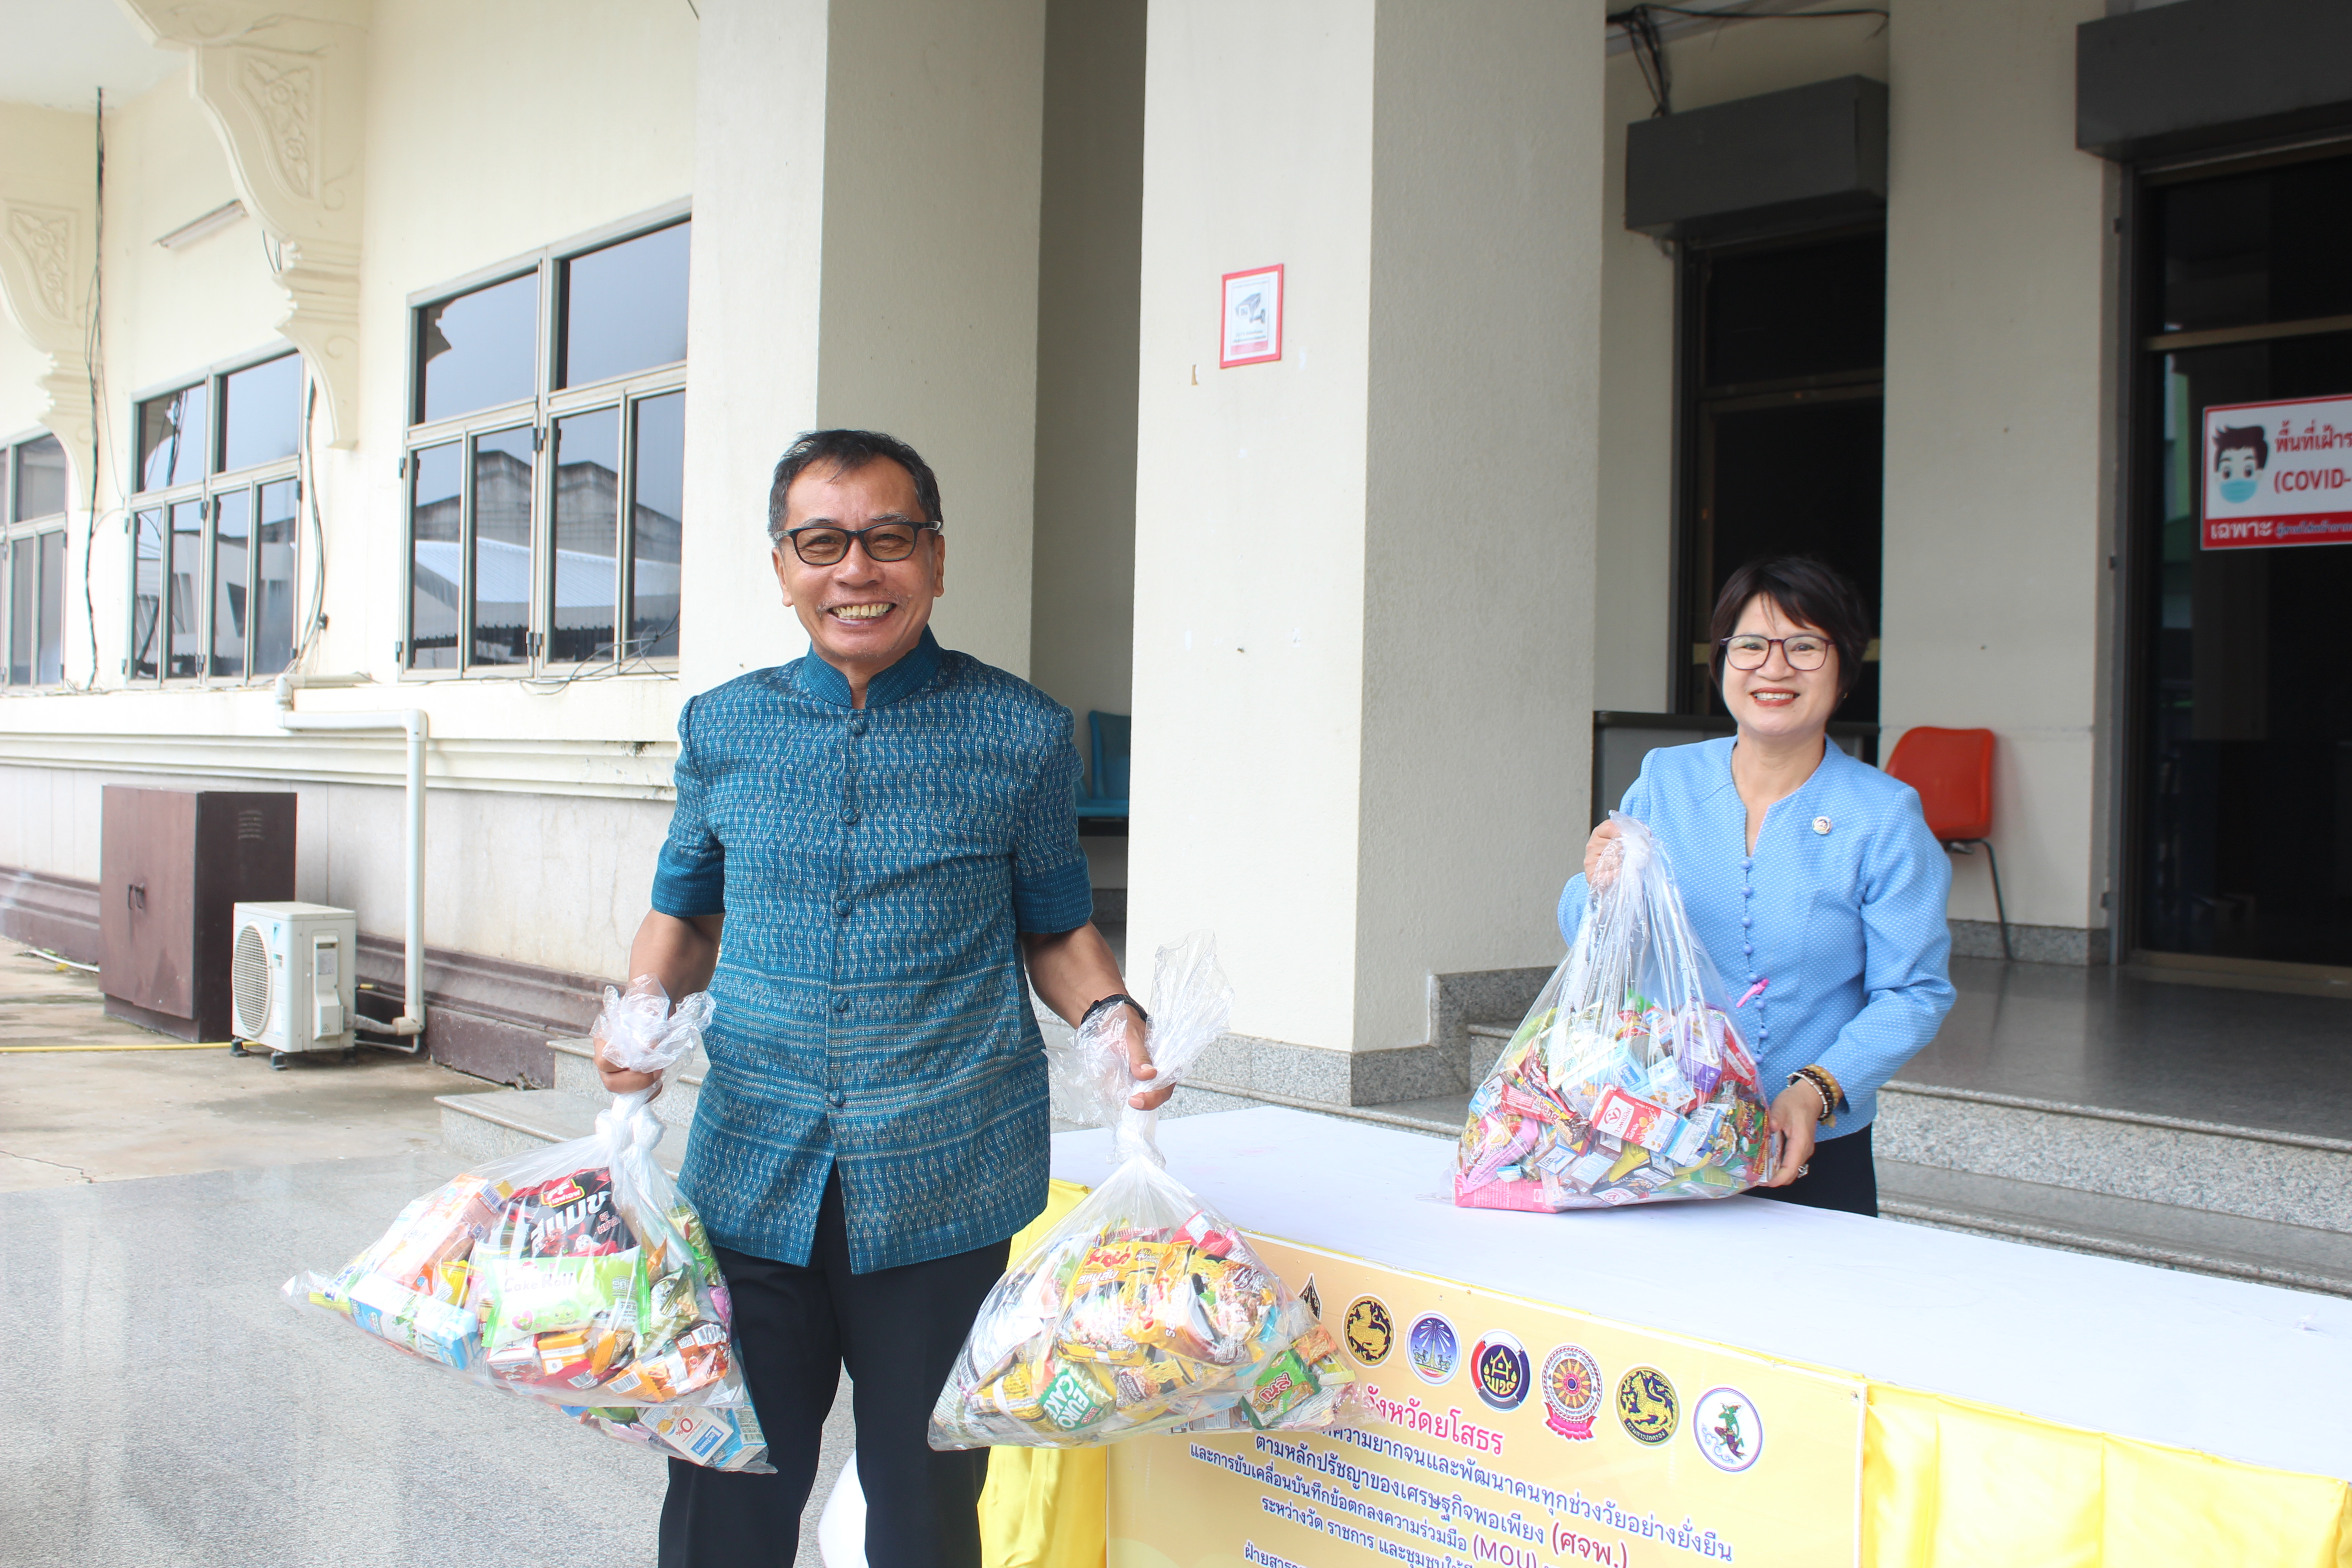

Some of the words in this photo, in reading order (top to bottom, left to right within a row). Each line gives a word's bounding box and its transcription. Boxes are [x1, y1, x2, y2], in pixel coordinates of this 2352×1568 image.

[2210, 520, 2273, 539] เฉพาะ
[1476, 1143, 1504, 1169] Strawberry
[552, 1189, 581, 1205] เอฟเอฟ
[599, 1210, 609, 1222] รส
[505, 1277, 538, 1293] Cake
[542, 1272, 573, 1289] Roll
[1044, 1375, 1075, 1420] CAKE
[1058, 1387, 1090, 1429] EURO
[675, 1417, 694, 1437] 0%
[1081, 1406, 1100, 1425] EURO
[696, 1427, 722, 1454] Lactasoy
[1190, 1444, 1467, 1551] และการขับเคลื่อนบันทึกข้อตกลงความร่วมมือ
[1473, 1534, 1537, 1568] (MOU)
[1256, 1435, 1544, 1544] ตามหลักปรัชญาของเศรษฐกิจพอเพียง
[1552, 1522, 1627, 1568] (ศจพ.)
[1262, 1497, 1323, 1531] ระหว่างวัด
[1327, 1521, 1375, 1549] ราชการ
